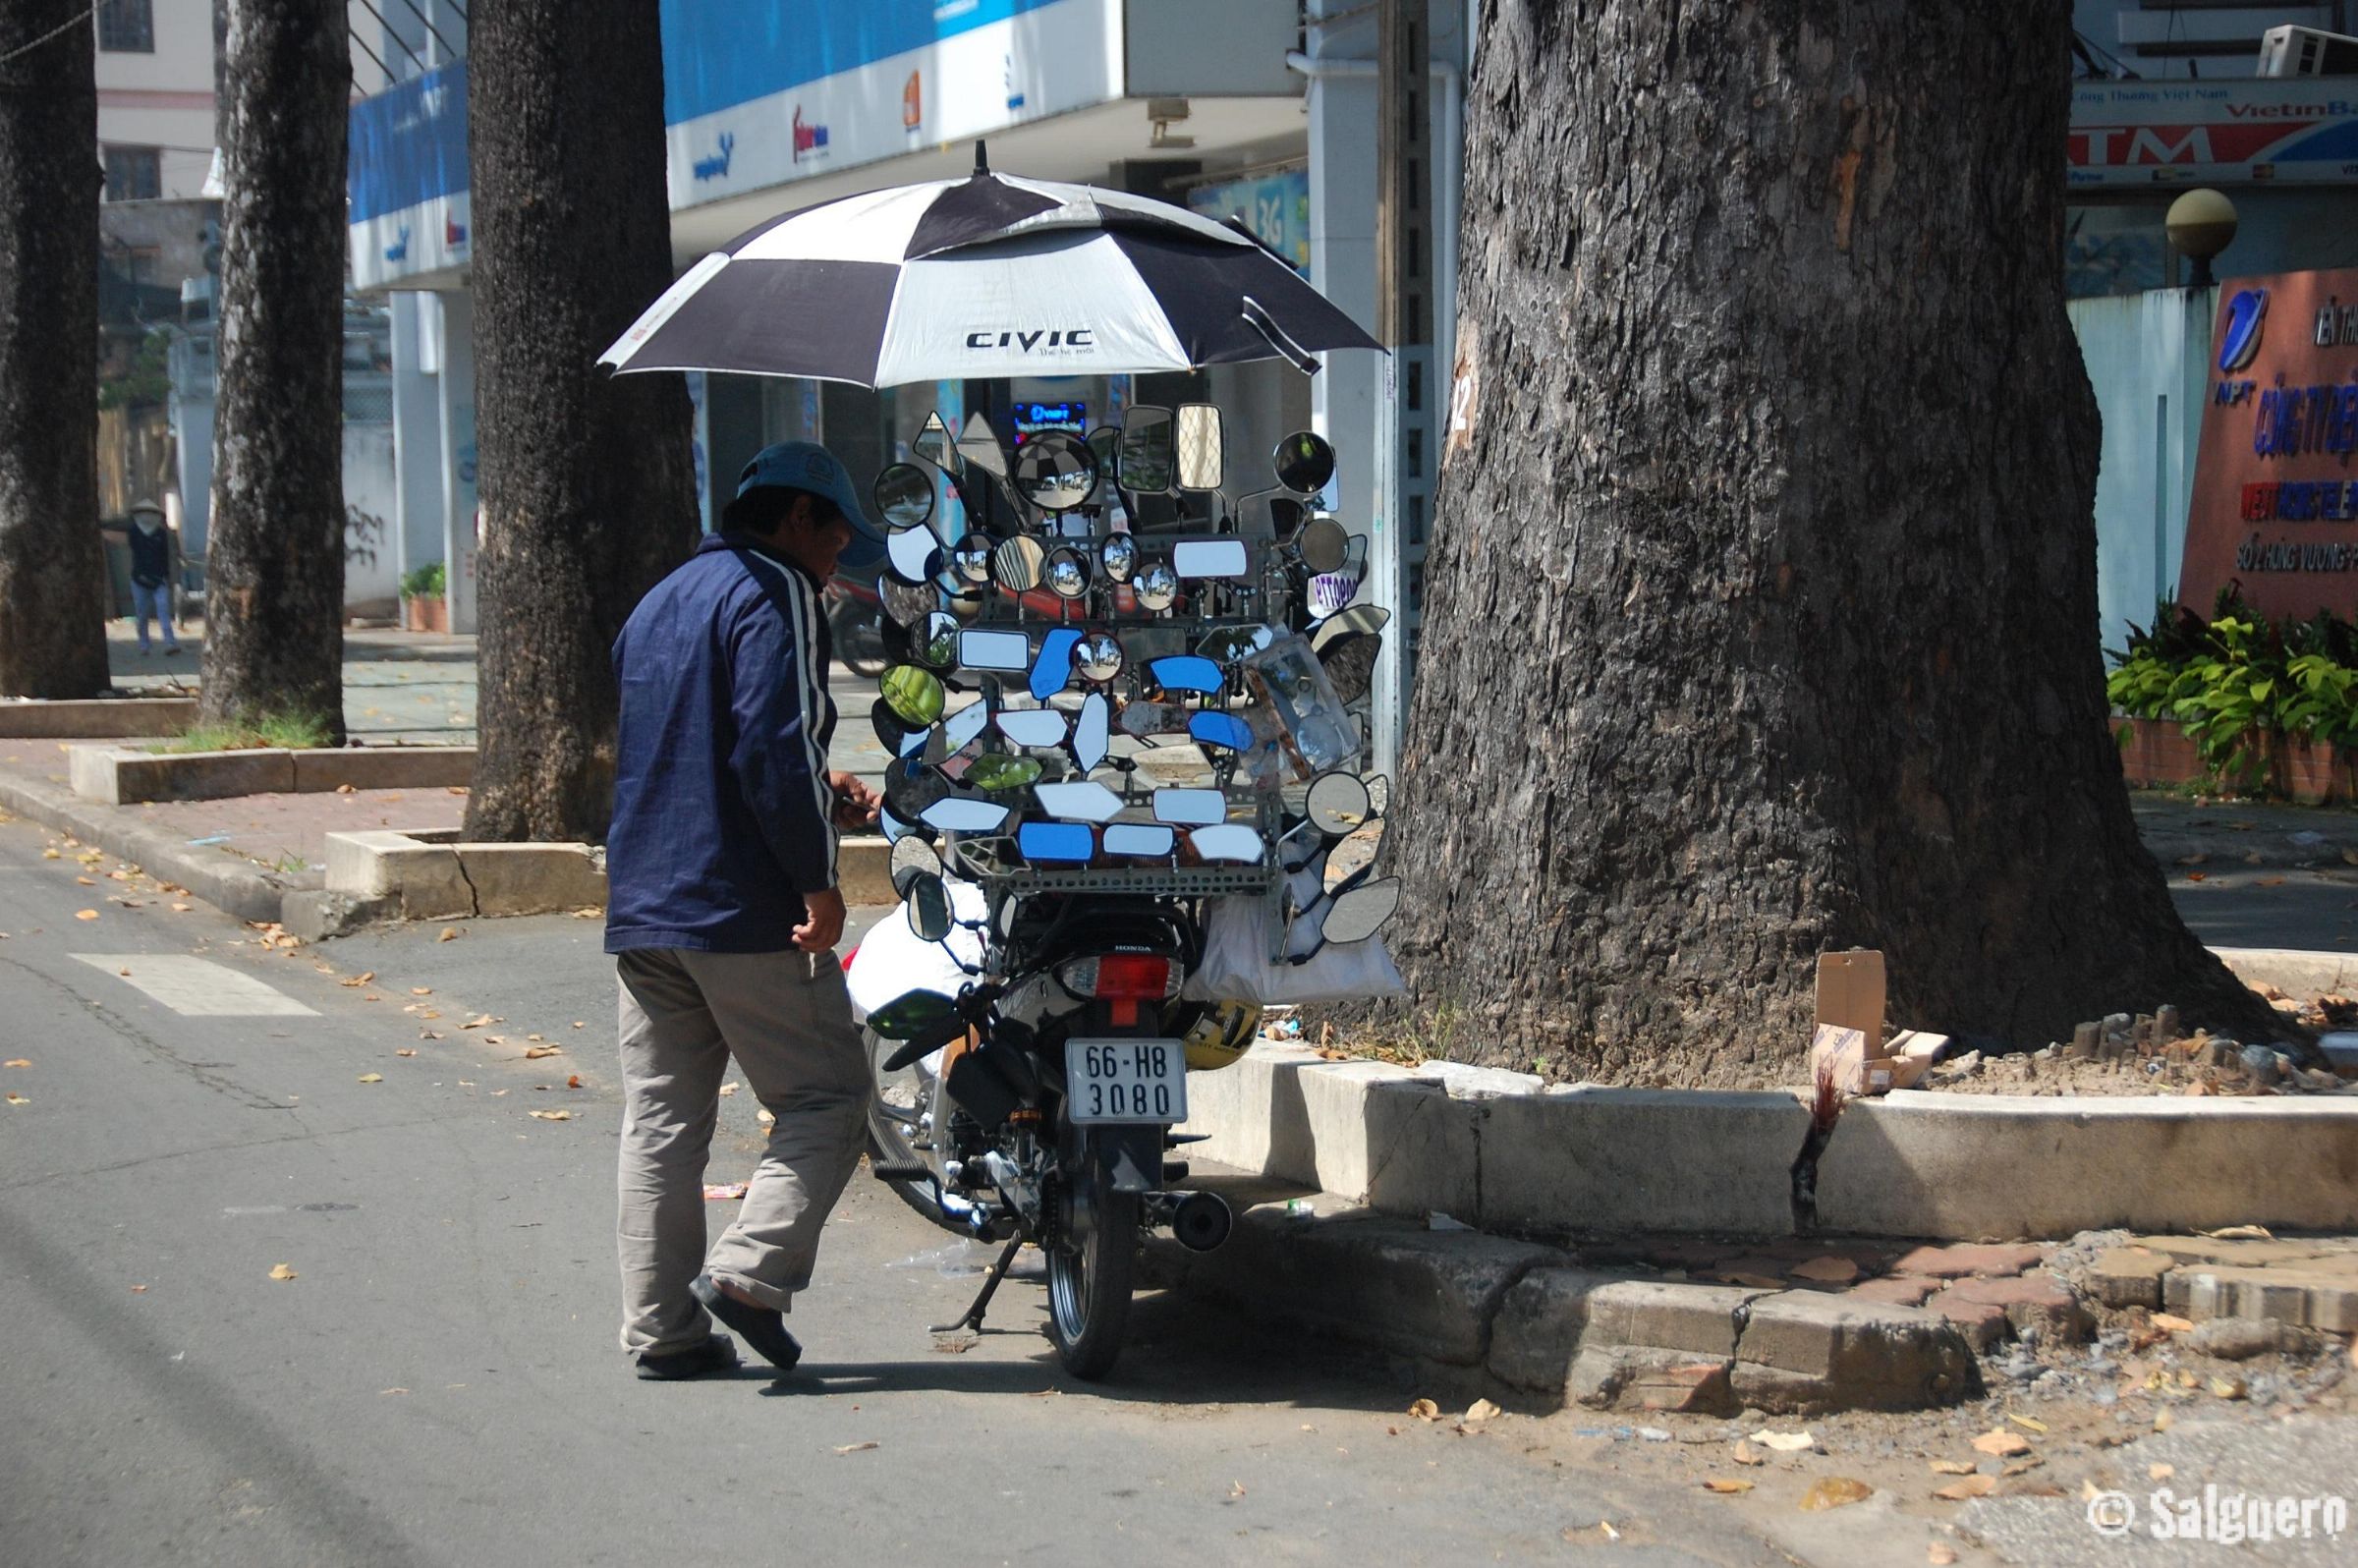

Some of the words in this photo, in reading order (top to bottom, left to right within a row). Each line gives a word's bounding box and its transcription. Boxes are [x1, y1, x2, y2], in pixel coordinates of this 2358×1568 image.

[2196, 86, 2228, 99] Nam
[2066, 125, 2216, 166] TM
[966, 329, 1093, 354] CIVIC
[1086, 1045, 1167, 1079] 66-H8
[1088, 1084, 1170, 1116] 3080
